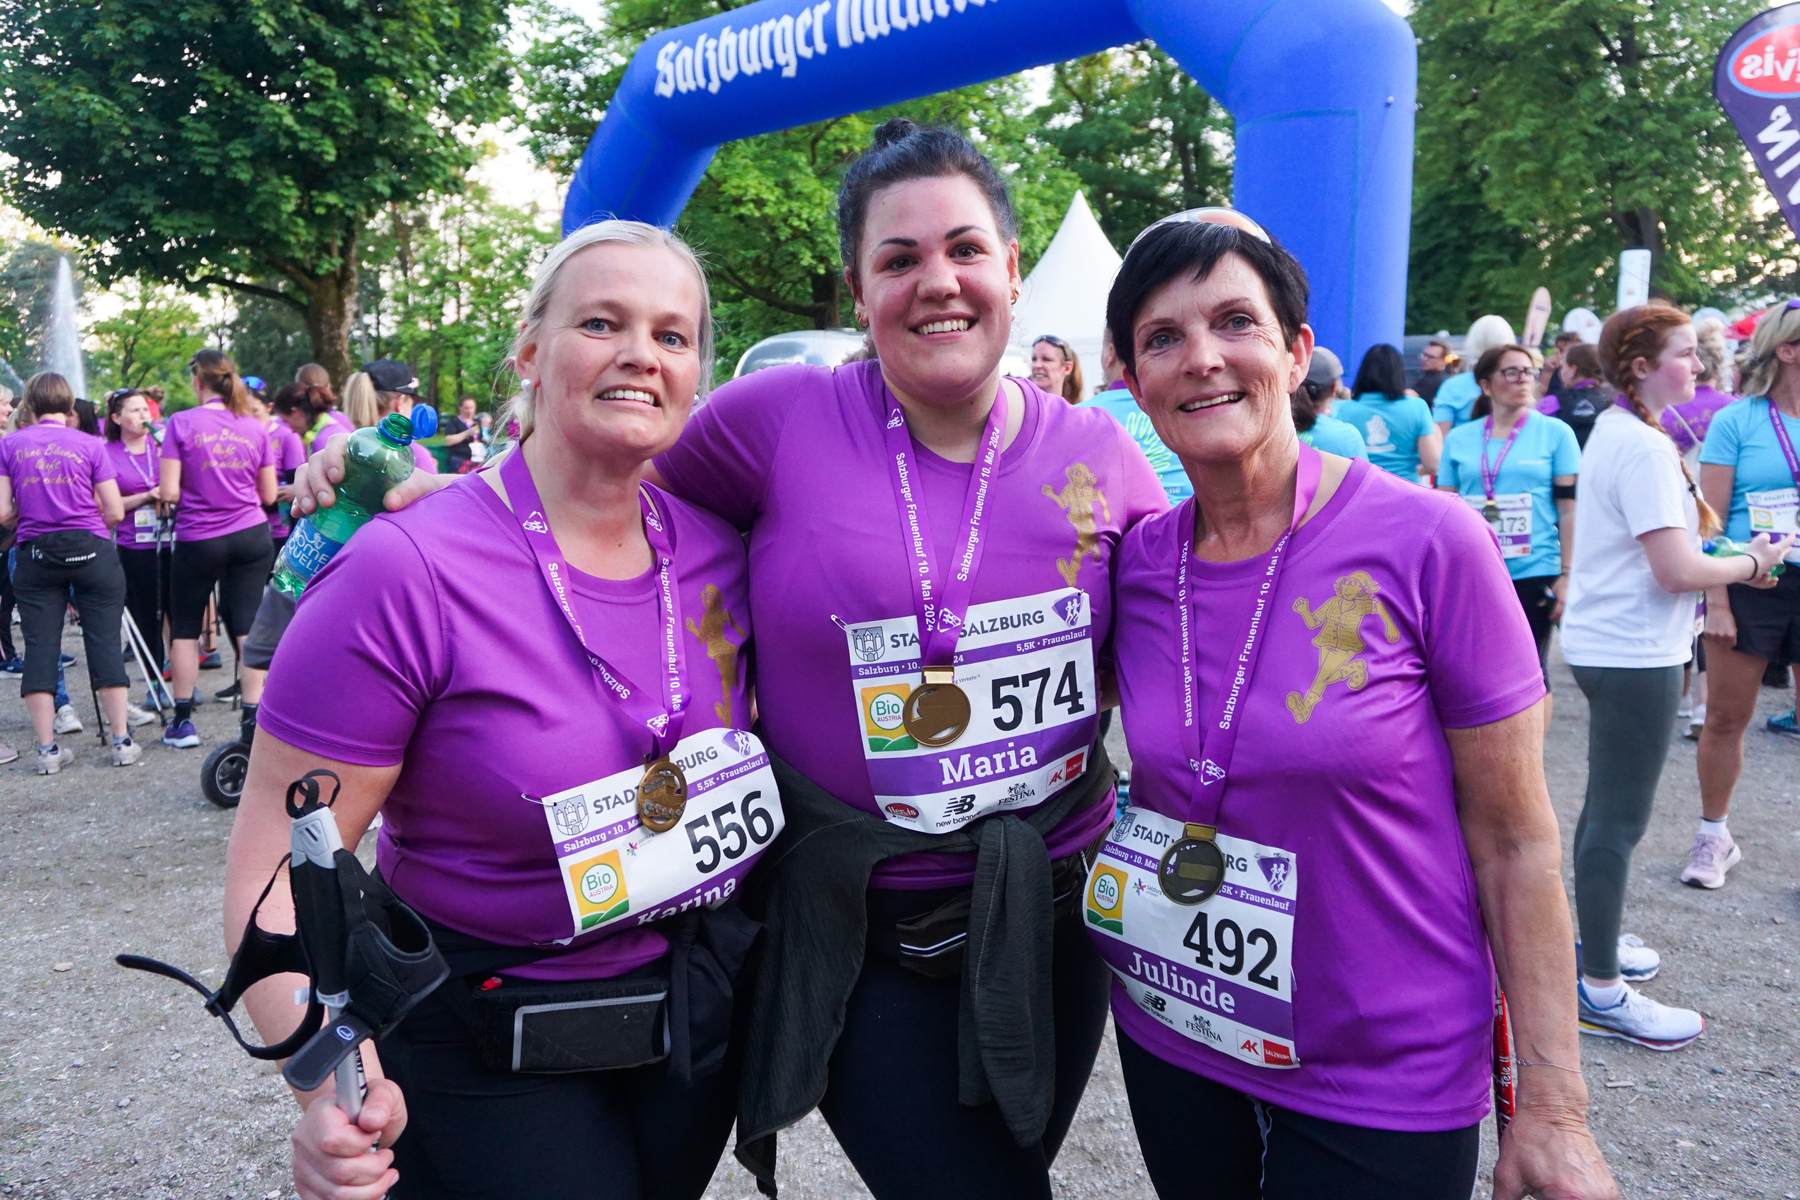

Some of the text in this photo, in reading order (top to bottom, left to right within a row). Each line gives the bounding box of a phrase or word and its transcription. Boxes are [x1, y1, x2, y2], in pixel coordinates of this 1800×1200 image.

[655, 1, 831, 98] Salzburger
[957, 428, 1000, 581] Salzburger Frauenlauf 10. Mai 2024
[896, 453, 935, 632] Salzburger Frauenlauf 10. Mai 2024
[548, 562, 577, 623] Salzburger
[660, 558, 673, 614] Salzburger
[666, 616, 678, 674] Frauenlauf
[959, 610, 1044, 638] SALZBURG
[1179, 604, 1189, 663] Frauenlauf
[1219, 532, 1292, 729] Salzburger Frauenlauf 10. Mai 202
[858, 665, 899, 676] Salzburg
[907, 661, 920, 671] 10.
[1016, 642, 1035, 652] 5,5K
[1042, 629, 1086, 646] Frauenlauf
[669, 676, 680, 692] 10.
[875, 700, 900, 716] Bio
[992, 660, 1085, 731] 574
[1184, 666, 1192, 726] Salzburger
[939, 742, 1038, 785] Maria
[1048, 769, 1063, 786] AK
[563, 832, 607, 853] Salzburg
[613, 825, 626, 835] 10.
[697, 779, 715, 791] 5,5K
[720, 756, 764, 780] Frauenlauf
[998, 789, 1035, 805] FESTINA
[685, 791, 775, 873] 556
[1132, 824, 1170, 847] STADT
[586, 872, 611, 891] Bio
[589, 884, 614, 898] AUSTRIA
[637, 877, 736, 926] Karina
[1096, 893, 1114, 904] AUSTRIA
[1098, 878, 1115, 898] Bio
[1104, 844, 1129, 861] Salzburg
[1133, 854, 1143, 864] 10.
[1144, 858, 1159, 870] Mai
[1240, 889, 1290, 911] Frauenlauf
[1183, 911, 1279, 991] 492
[1128, 951, 1236, 1014] Julinde
[1185, 1020, 1223, 1042] FESTINA
[1240, 1039, 1260, 1056] AK
